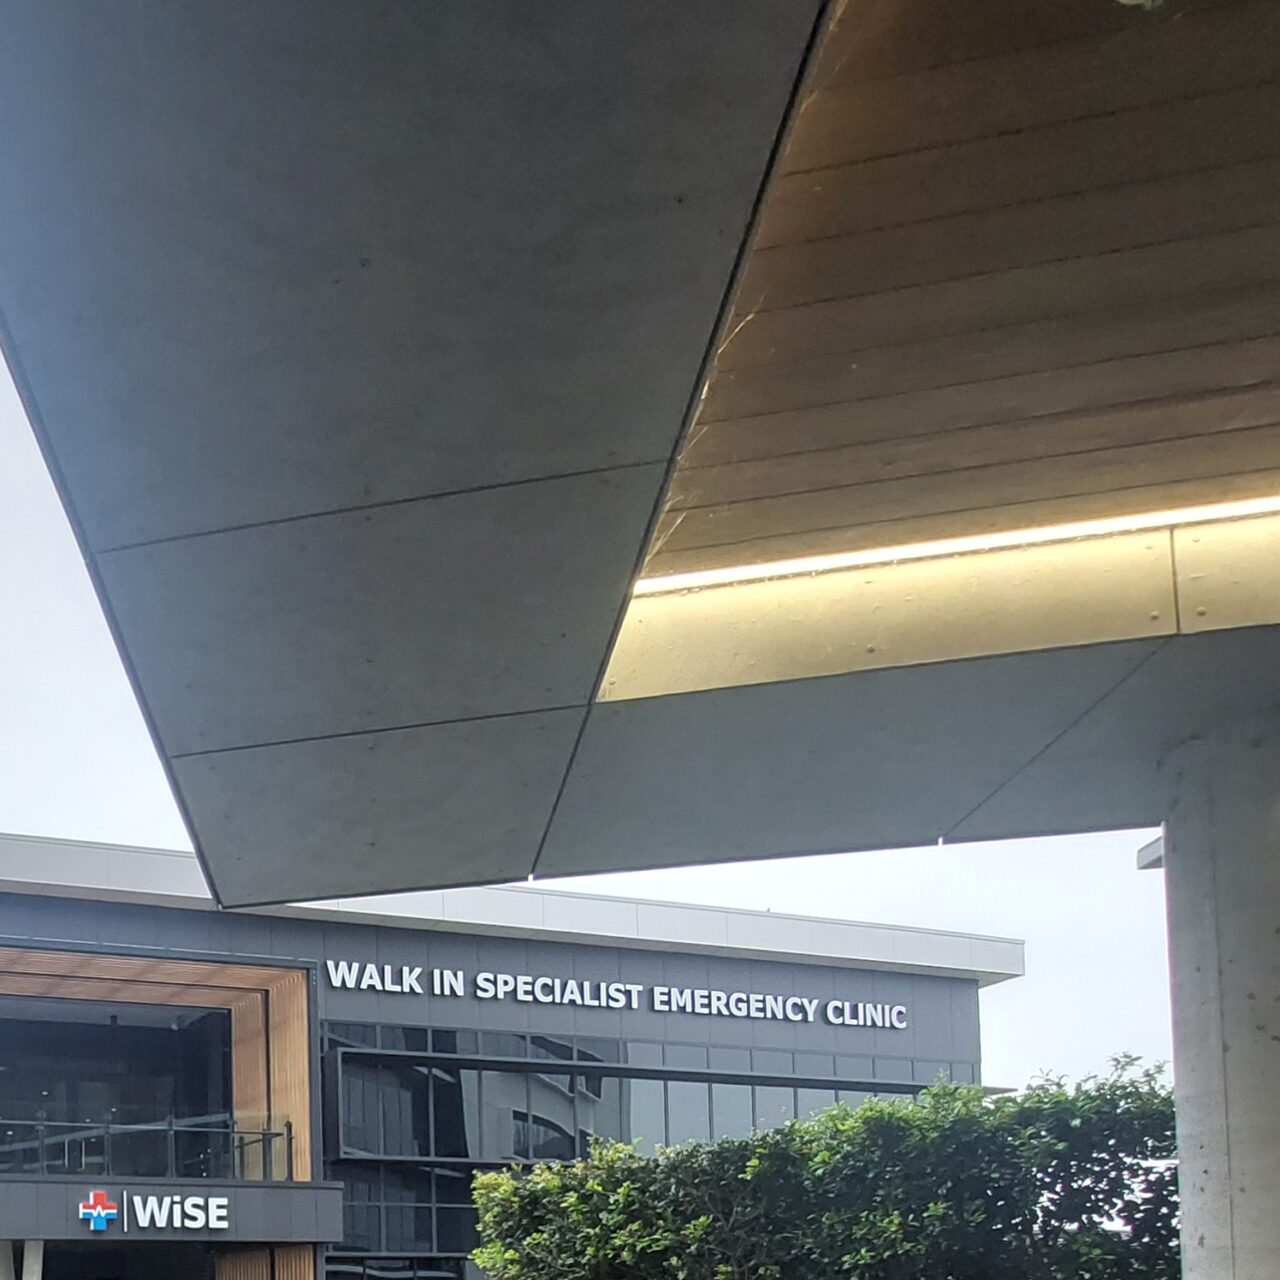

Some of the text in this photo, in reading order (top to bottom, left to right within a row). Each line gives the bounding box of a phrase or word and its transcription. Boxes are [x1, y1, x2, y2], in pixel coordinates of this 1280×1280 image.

[326, 960, 907, 1029] WALK IN SPECIALIST EMERGENCY CLINIC
[132, 1195, 229, 1229] WiSE
